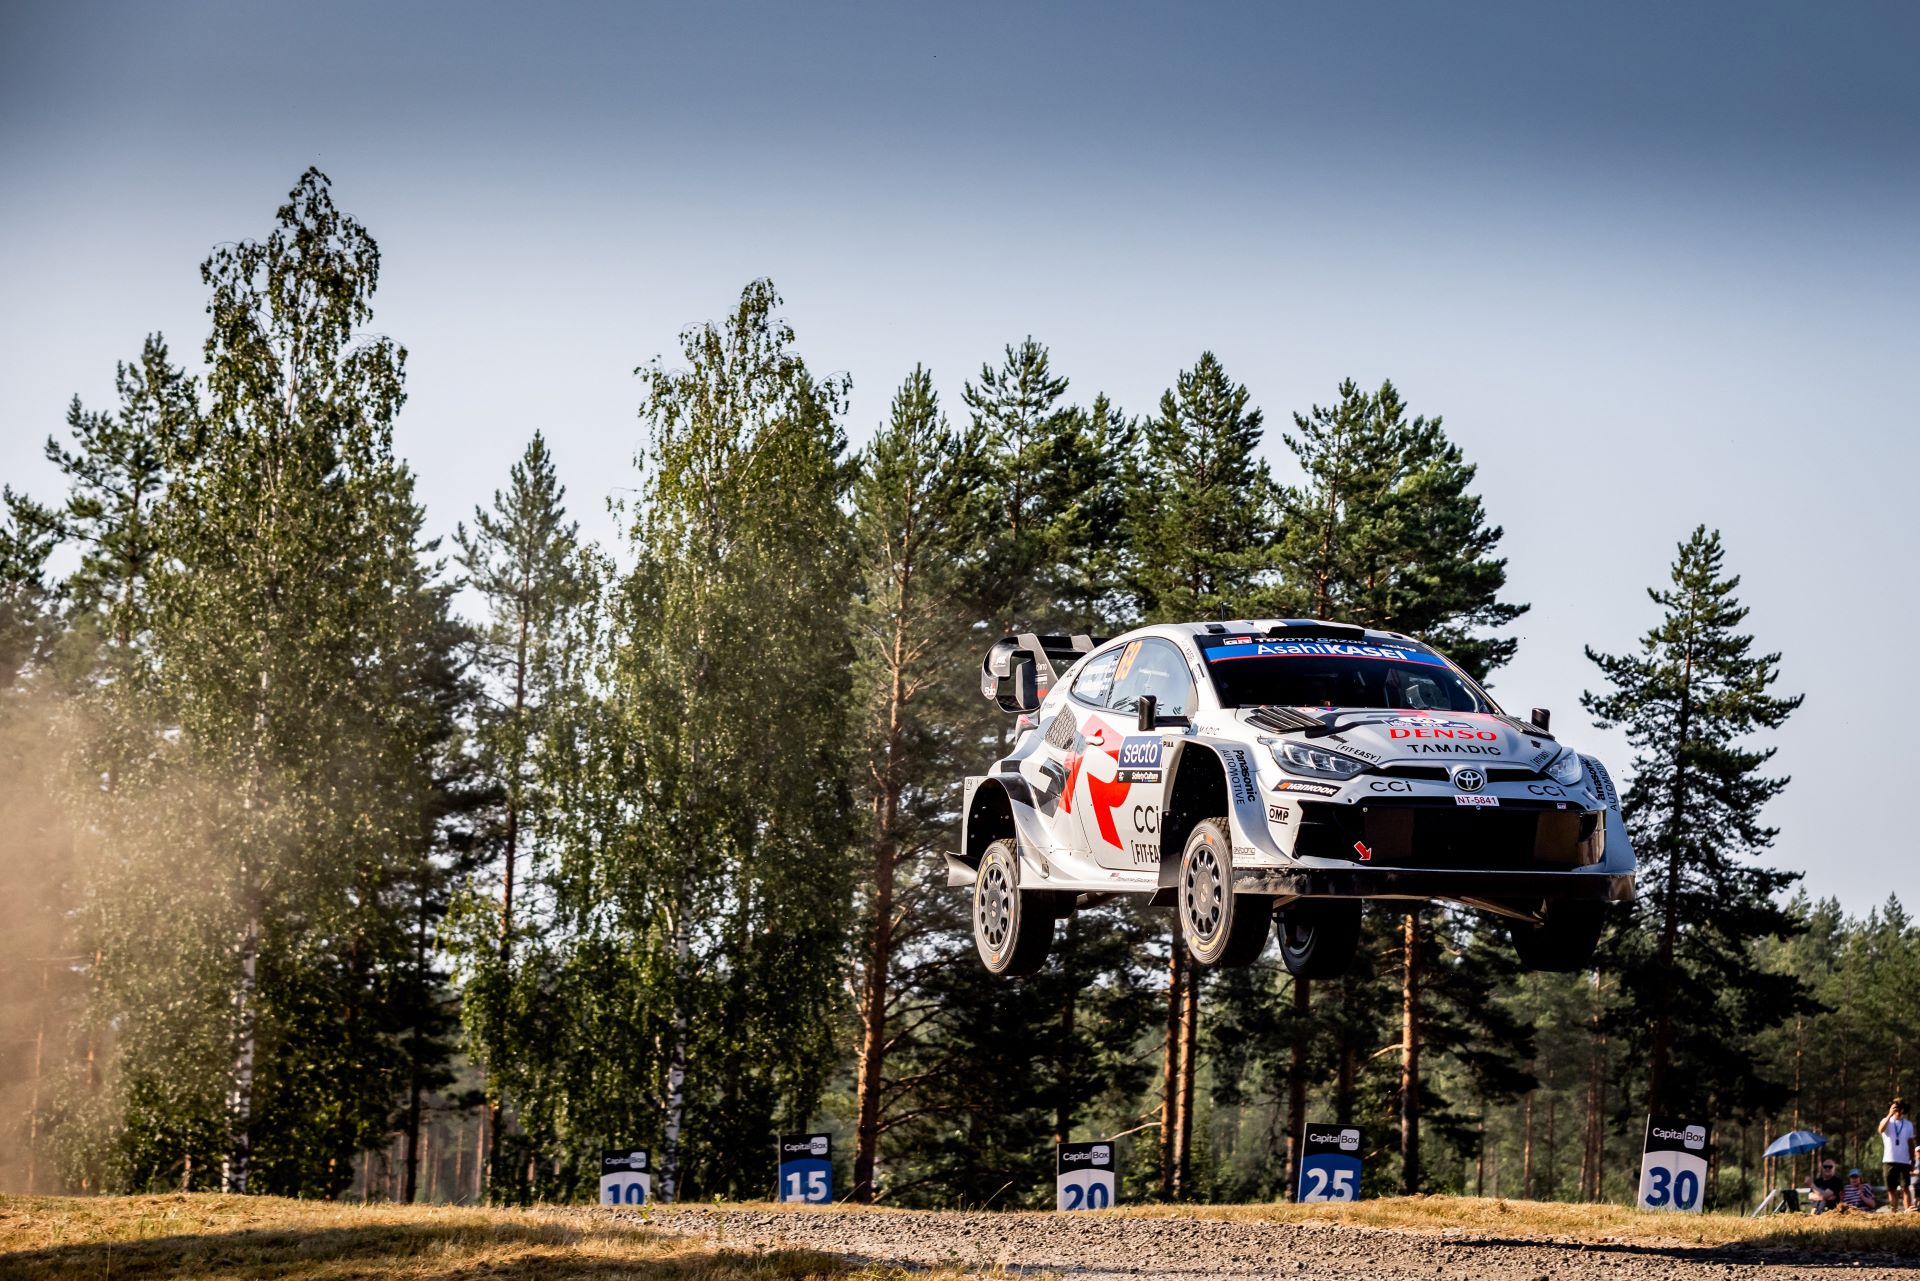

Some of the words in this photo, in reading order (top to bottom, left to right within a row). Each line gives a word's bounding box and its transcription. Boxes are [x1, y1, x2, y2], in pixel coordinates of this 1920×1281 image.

[1316, 637, 1368, 645] GAZOO
[1389, 728, 1497, 741] DENSO
[1123, 740, 1158, 764] secto
[1407, 744, 1502, 756] TAMADIC
[1221, 749, 1246, 805] AUTOMOTIVE
[1233, 749, 1256, 803] Panasonic
[1370, 781, 1412, 792] CCi
[1527, 784, 1567, 797] CCi
[1457, 796, 1497, 805] NT-5841
[1269, 807, 1289, 821] OMP
[1309, 1133, 1359, 1145] CapitalBox
[1652, 1127, 1705, 1143] CapitalBox
[784, 1141, 828, 1152] CapitalBox
[1063, 1151, 1109, 1162] CapitalBox
[786, 1170, 828, 1202] 15
[1304, 1167, 1354, 1203] 25
[1645, 1166, 1699, 1210] 30
[607, 1183, 645, 1204] 10
[1063, 1182, 1109, 1211] 20
